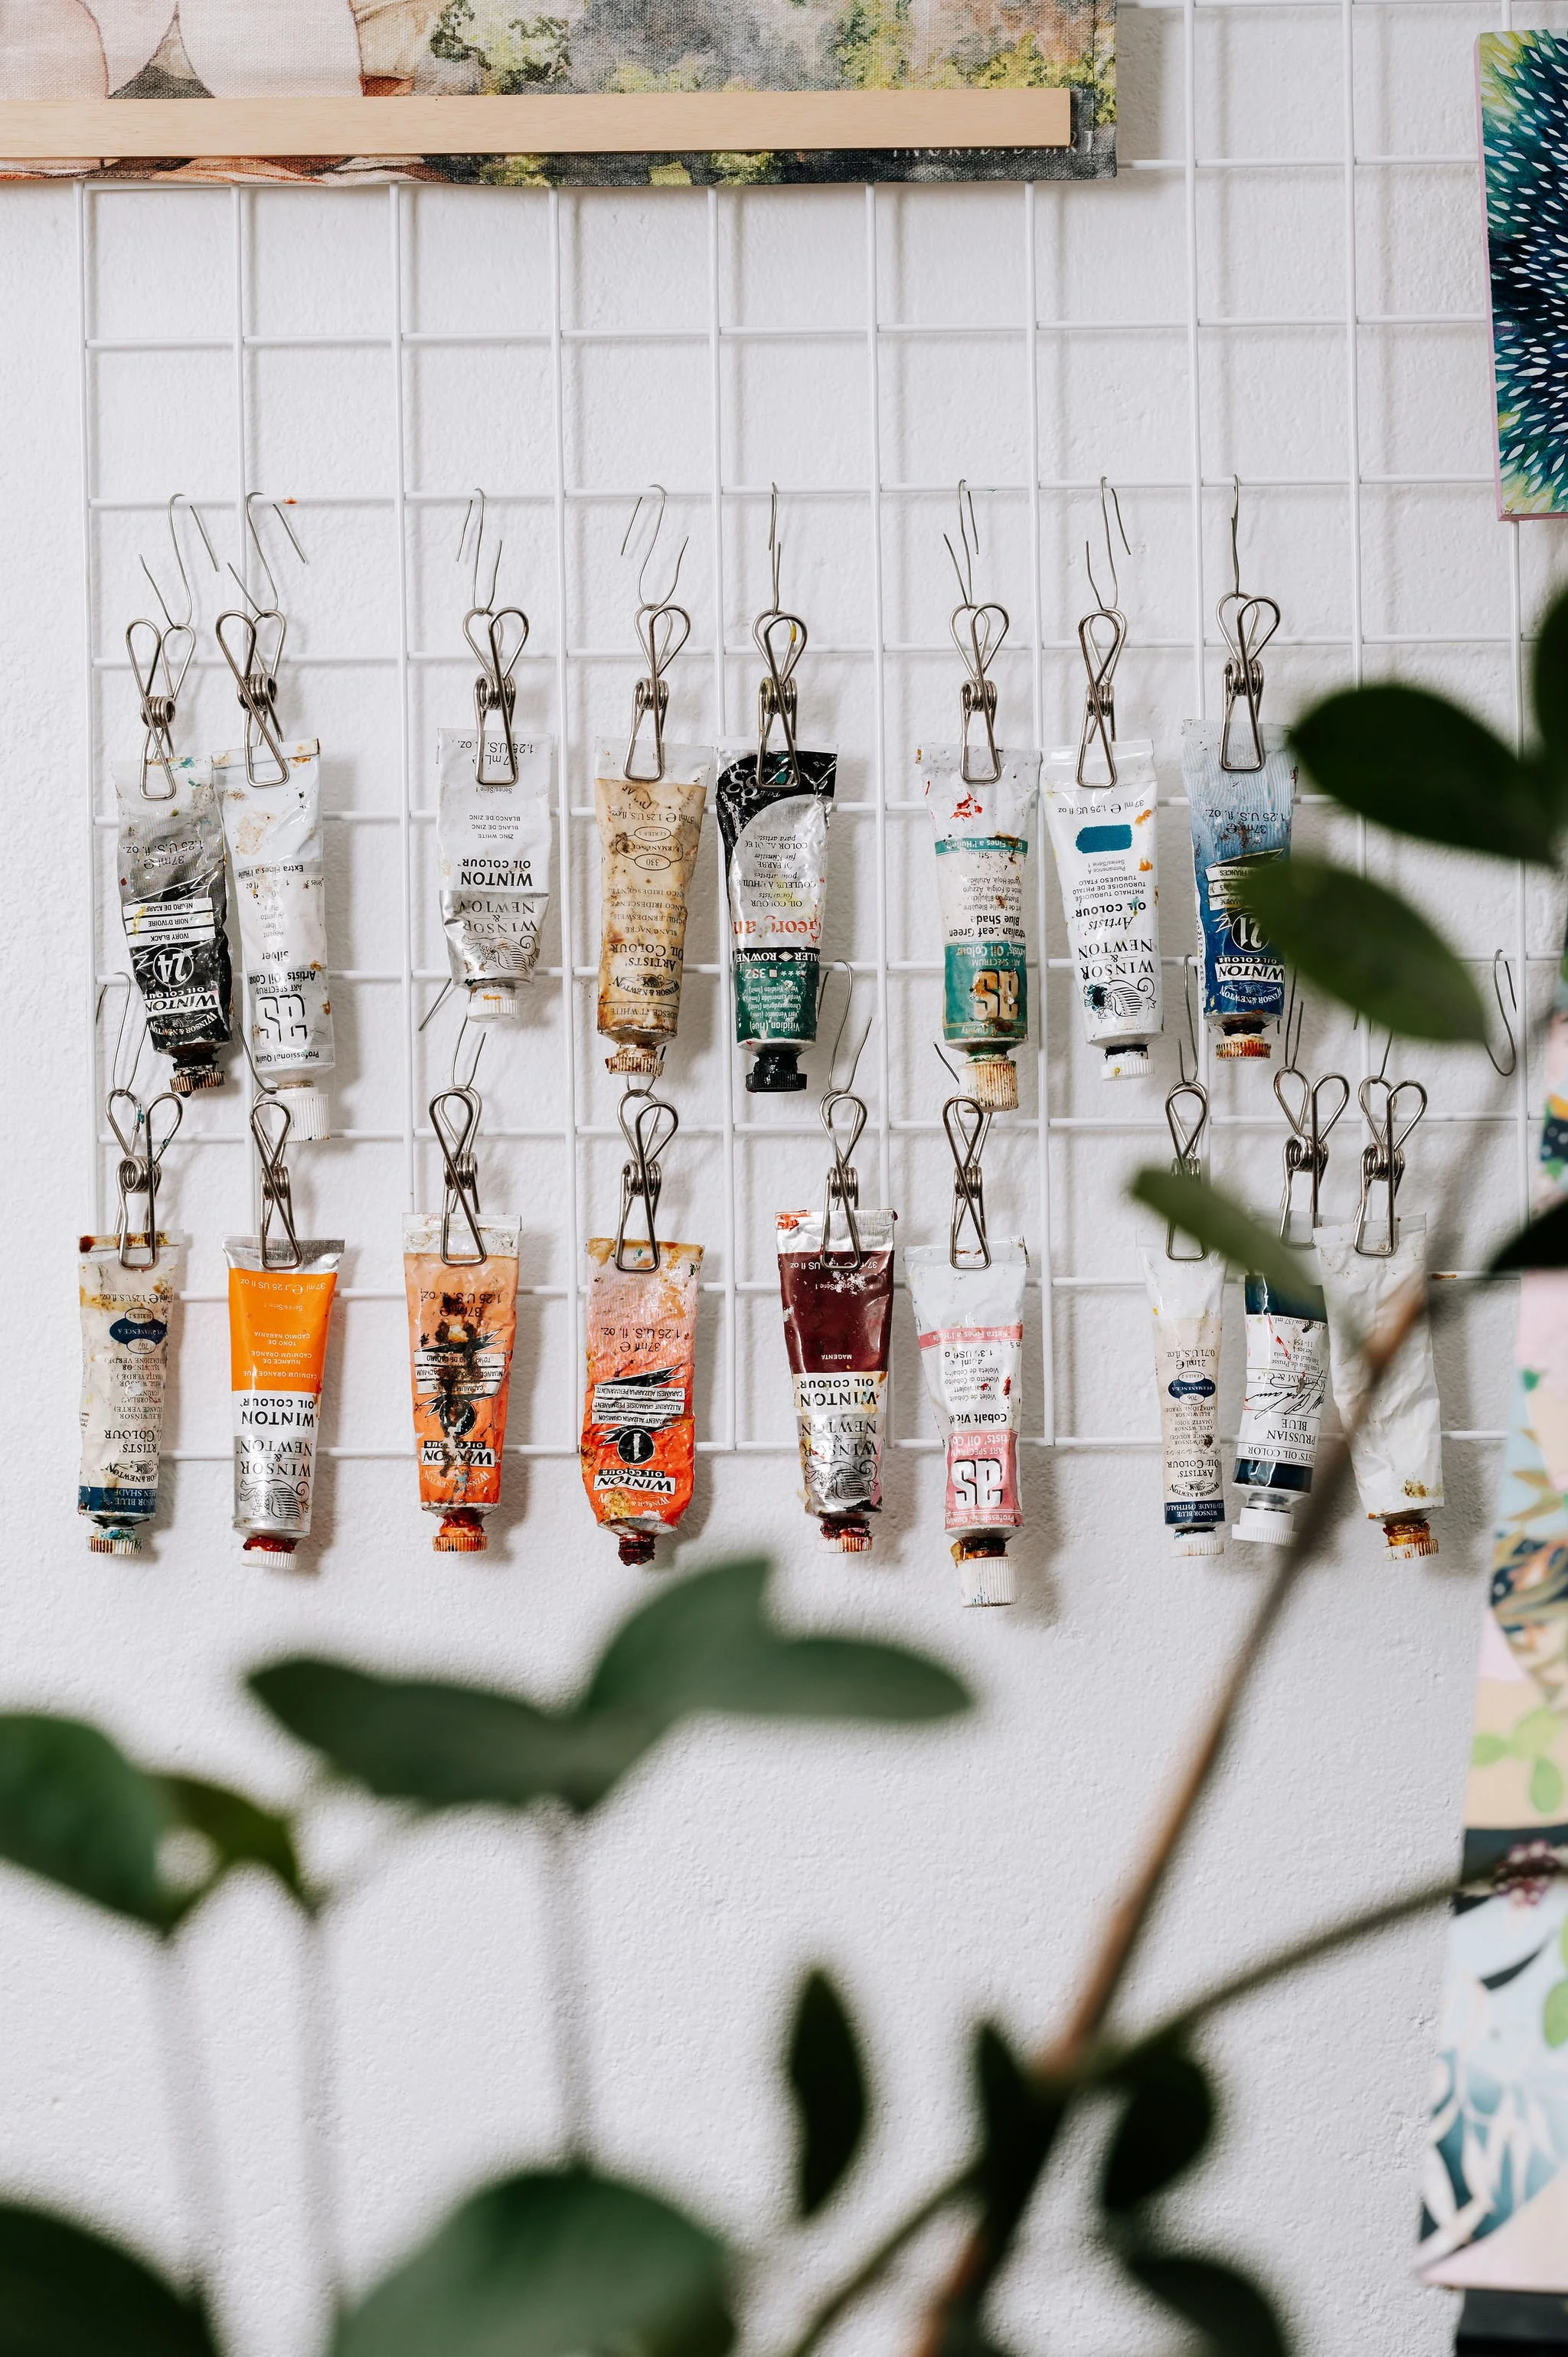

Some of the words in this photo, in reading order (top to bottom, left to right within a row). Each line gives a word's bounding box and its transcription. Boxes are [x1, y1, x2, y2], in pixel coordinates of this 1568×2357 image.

[488, 742, 508, 753] U.S.
[1205, 809, 1220, 818] oz.
[1225, 810, 1233, 819] fl.
[1236, 812, 1259, 822] U.S.
[1263, 812, 1285, 822] 1.25
[154, 843, 177, 854] U.S.
[514, 860, 531, 868] OIL
[461, 871, 533, 886] WINTON
[1075, 892, 1112, 902] TURQUOISE
[459, 900, 534, 914] NEWTON
[970, 915, 1001, 925] Shade
[1004, 916, 1020, 926] Blue
[1240, 917, 1262, 949] 21
[610, 943, 666, 956] COLOUR
[671, 946, 684, 960] OIL
[957, 946, 988, 957] Colour
[991, 946, 1004, 956] Oil
[1078, 939, 1153, 959] NEWTON
[262, 951, 288, 961] Silver
[158, 953, 186, 982] 24
[1080, 959, 1154, 980] WINSOR
[1219, 966, 1284, 980] WINTON
[268, 973, 280, 985] Oil
[612, 976, 648, 995] NEWTON
[655, 980, 680, 996] WINSOR
[1220, 986, 1251, 1003] NEWTON
[1259, 987, 1282, 1003] WINSOR
[145, 995, 217, 1012] WINTON
[149, 1021, 178, 1035] NEWTON
[185, 1012, 217, 1034] WINSOR
[750, 1020, 769, 1034] (Hue)
[771, 1022, 800, 1032] Viridian
[479, 1294, 501, 1304] 1.25
[619, 1328, 628, 1338] fl.
[632, 1328, 654, 1339] U.S.
[658, 1329, 680, 1339] 1.25
[1187, 1359, 1206, 1368] 21ml
[854, 1378, 874, 1387] OIL
[298, 1400, 314, 1408] OIL
[800, 1391, 877, 1407] WINTON
[242, 1411, 314, 1428] WINTON
[1282, 1419, 1307, 1431] BLUE
[104, 1430, 155, 1443] COLOUR
[835, 1435, 842, 1443] &
[968, 1435, 981, 1447] Oil
[1267, 1430, 1316, 1445] PRUSSIAN
[240, 1440, 312, 1456] NEWTON
[633, 1433, 641, 1461] 1
[1248, 1447, 1280, 1457] COLOR
[273, 1453, 282, 1462] &
[1283, 1450, 1297, 1459] OIL
[240, 1461, 311, 1477] WINSOR
[1167, 1460, 1204, 1469] COLOUR
[1207, 1459, 1219, 1467] OIL
[106, 1462, 140, 1483] NEWTON
[597, 1476, 671, 1492] WINTON
